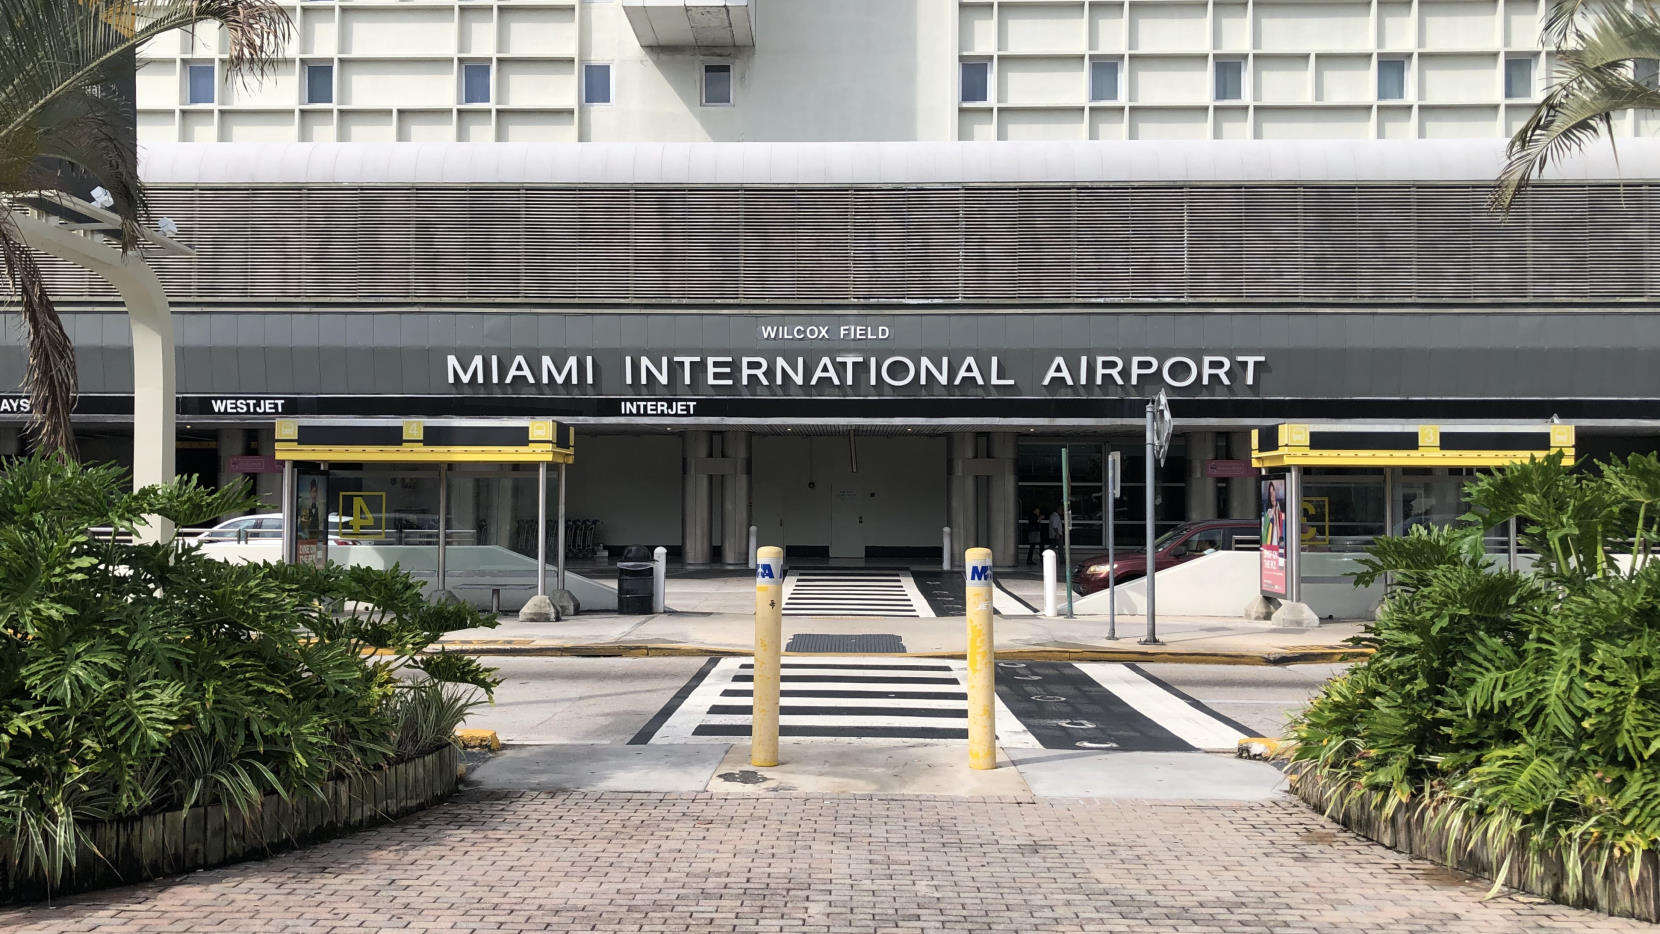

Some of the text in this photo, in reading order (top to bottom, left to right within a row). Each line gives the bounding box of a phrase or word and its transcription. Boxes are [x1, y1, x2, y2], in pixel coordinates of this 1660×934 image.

[761, 325, 890, 340] WILCOX FIELD
[446, 354, 1266, 388] MIAMI INTERNATIONAL AIRPORT
[0, 398, 31, 412] AYS
[211, 399, 285, 413] WESTJET
[621, 401, 697, 415] INTERJET
[408, 423, 418, 435] 4
[1423, 428, 1434, 442] 3
